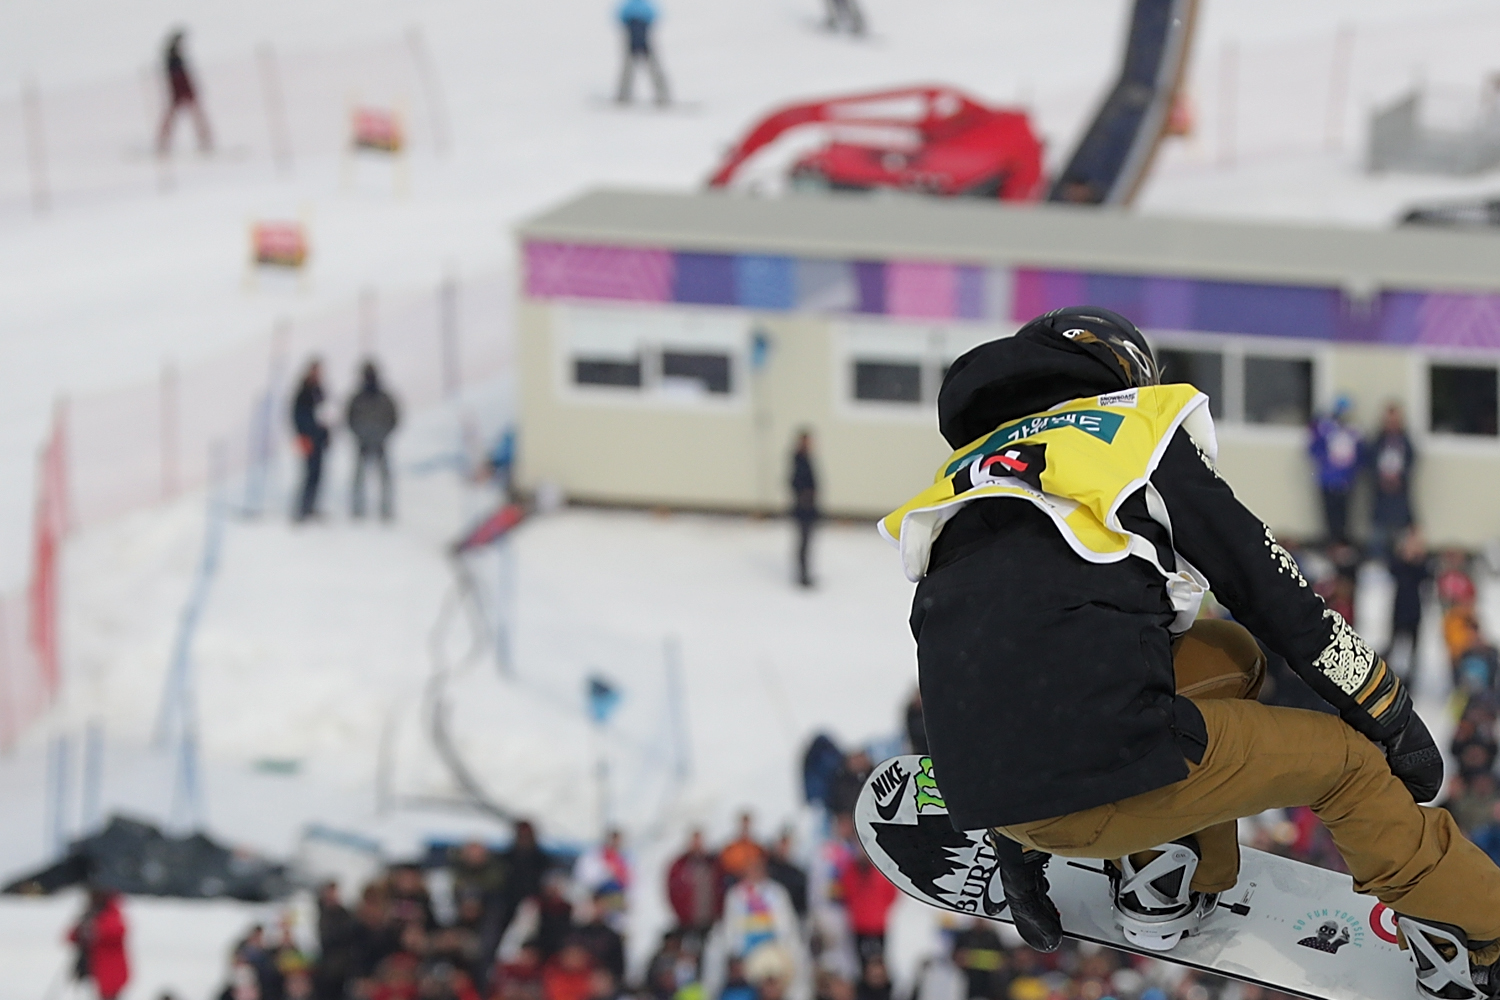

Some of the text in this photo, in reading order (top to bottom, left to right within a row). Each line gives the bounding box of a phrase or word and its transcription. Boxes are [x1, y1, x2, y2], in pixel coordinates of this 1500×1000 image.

[870, 760, 903, 802] NIKE
[1306, 908, 1328, 920] FUN
[1334, 909, 1365, 948] YOURSELF
